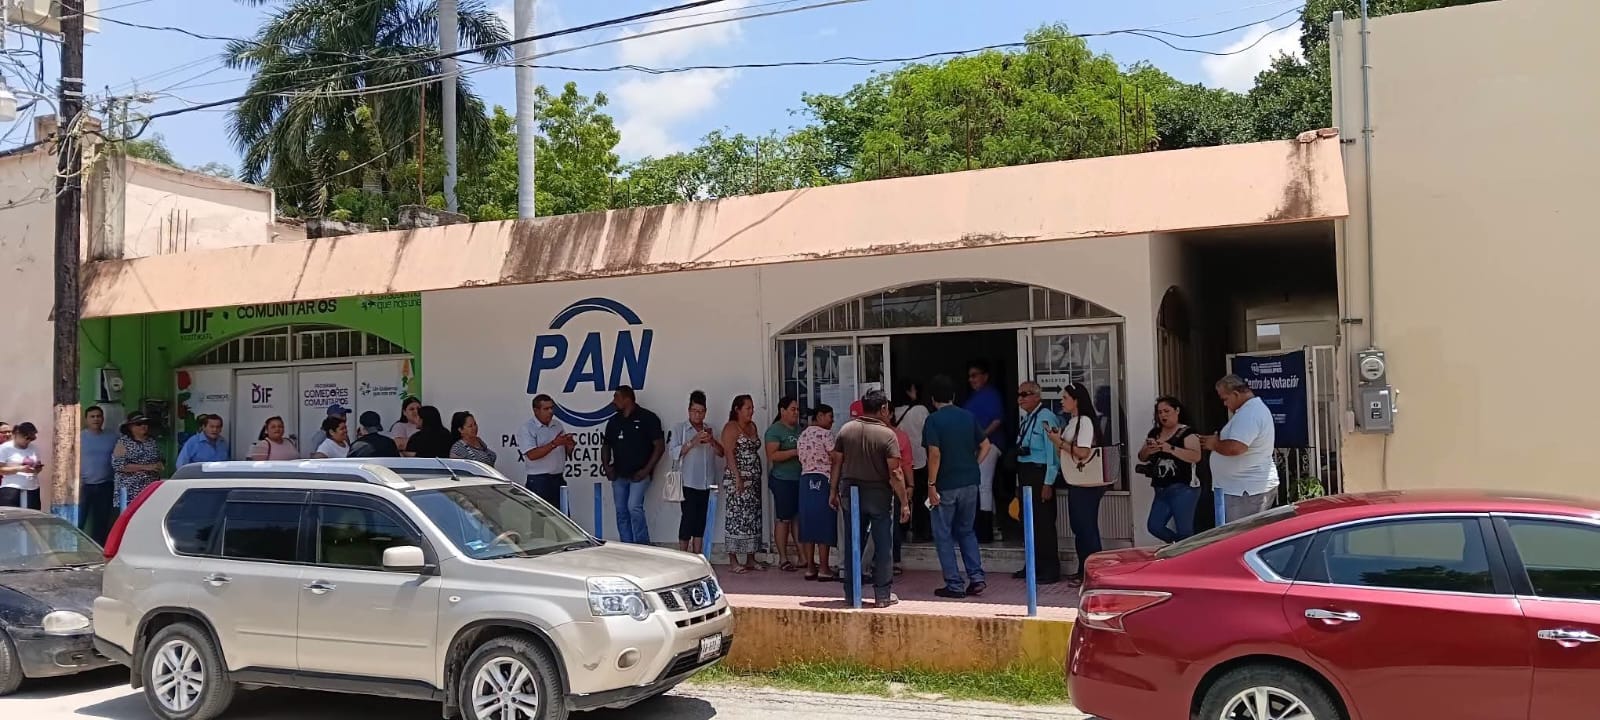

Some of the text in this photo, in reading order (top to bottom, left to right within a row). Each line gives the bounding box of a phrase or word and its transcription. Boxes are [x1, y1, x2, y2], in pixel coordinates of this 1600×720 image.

[527, 329, 653, 394] PAN
[1045, 340, 1106, 369] PAN
[251, 387, 273, 404] DIF
[304, 388, 348, 399] COMEDORES
